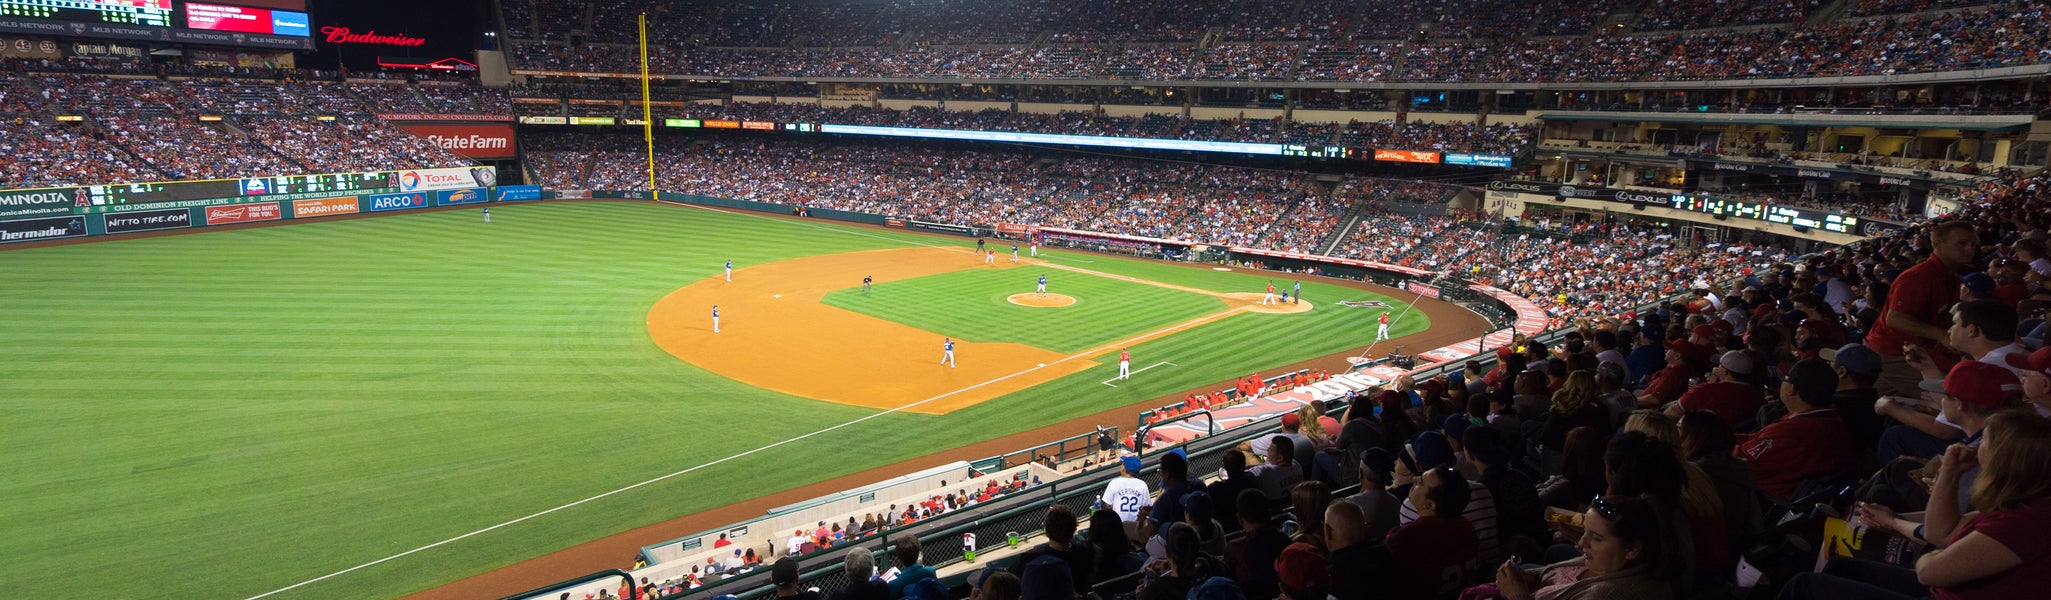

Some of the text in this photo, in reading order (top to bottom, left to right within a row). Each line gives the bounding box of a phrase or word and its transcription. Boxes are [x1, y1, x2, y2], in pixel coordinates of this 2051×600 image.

[321, 26, 426, 46] Budweiser
[73, 42, 142, 57] Captain Morgan
[424, 174, 462, 183] TOTAL
[0, 193, 68, 205] MINOLTA
[375, 196, 411, 209] ARCO
[1491, 200, 1517, 210] ANELS
[1629, 194, 1667, 204] LEXUS
[0, 207, 69, 216] onicaMinolta.com
[297, 205, 330, 215] SAFARI
[332, 204, 356, 212] PARK
[108, 213, 187, 227] NITTO TIRE.COM
[1417, 285, 1439, 297] TOYOTA
[1118, 488, 1141, 497] KERSHAW
[1120, 496, 1138, 512] 22
